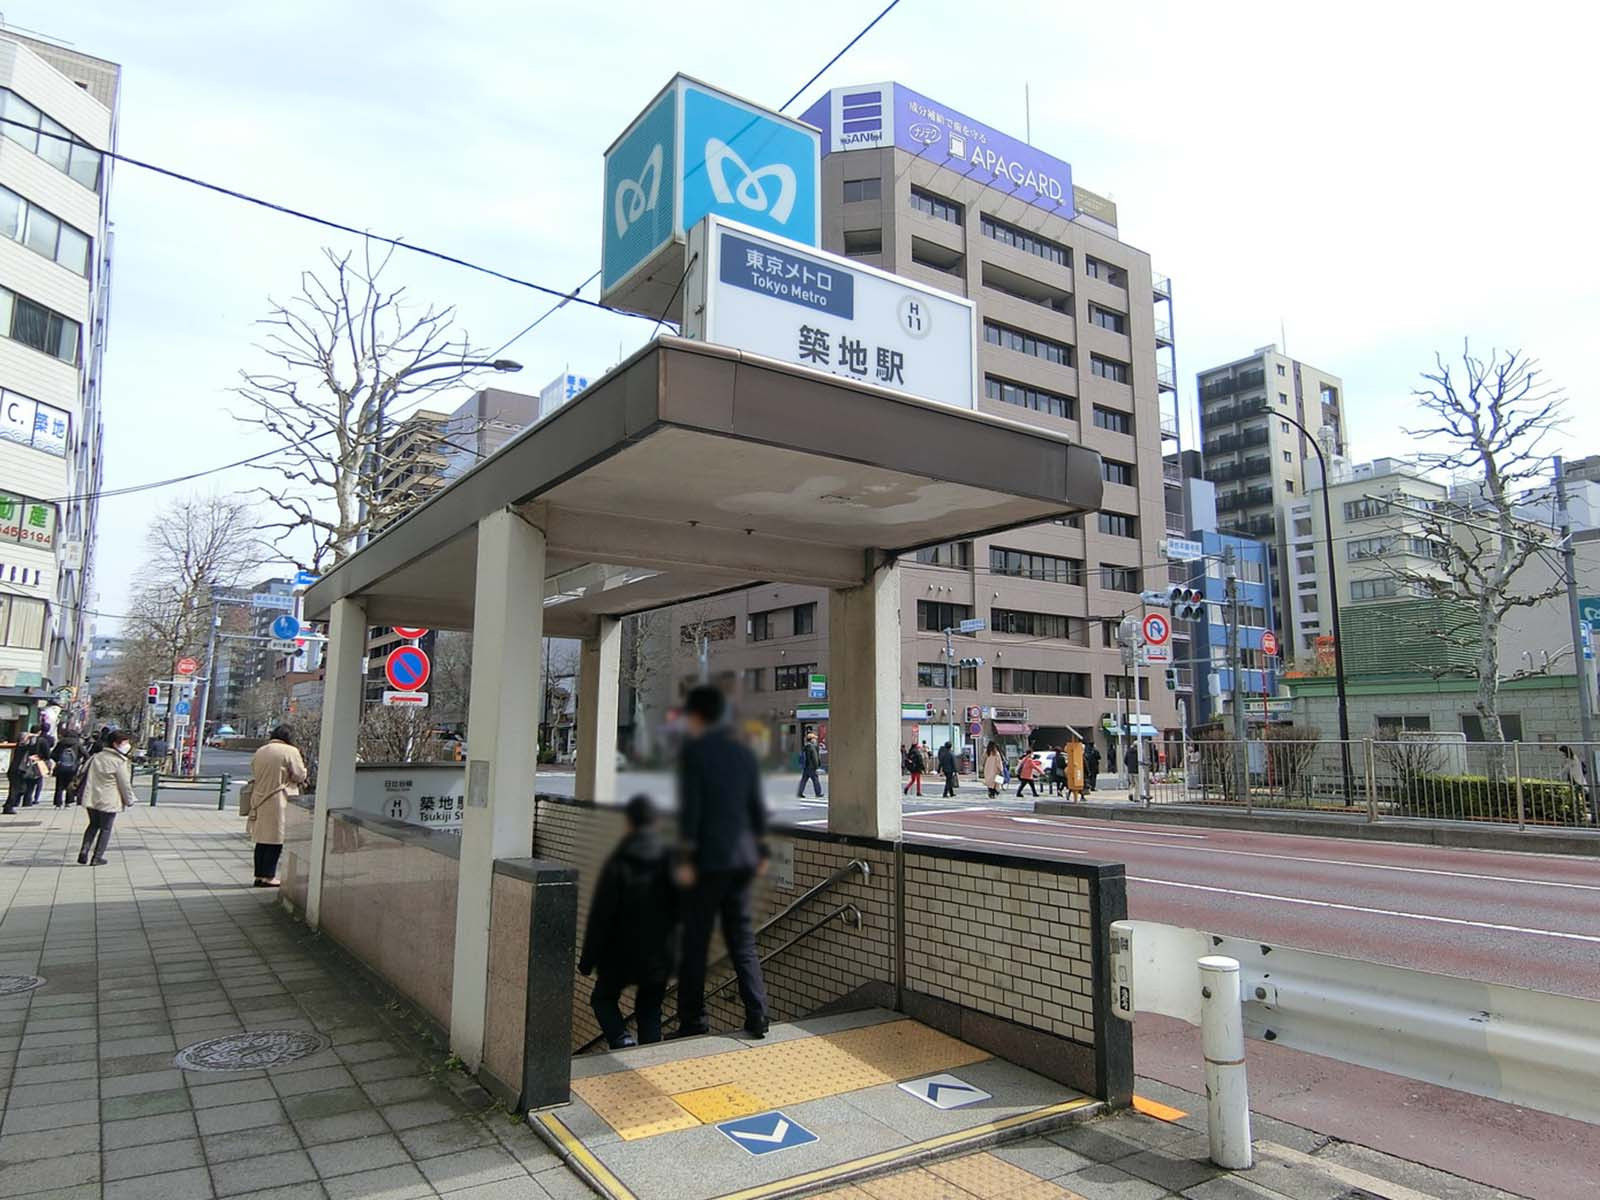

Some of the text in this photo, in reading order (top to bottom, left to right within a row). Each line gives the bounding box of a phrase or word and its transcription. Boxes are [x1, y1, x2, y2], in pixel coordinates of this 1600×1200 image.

[745, 248, 833, 292] 東京メトロ
[751, 271, 828, 307] Tokyo Metro
[909, 302, 920, 316] H
[907, 314, 922, 332] 11
[797, 324, 905, 386] 築地駅
[393, 799, 402, 808] H
[390, 808, 403, 818] 11
[419, 812, 452, 823] Tsukiji
